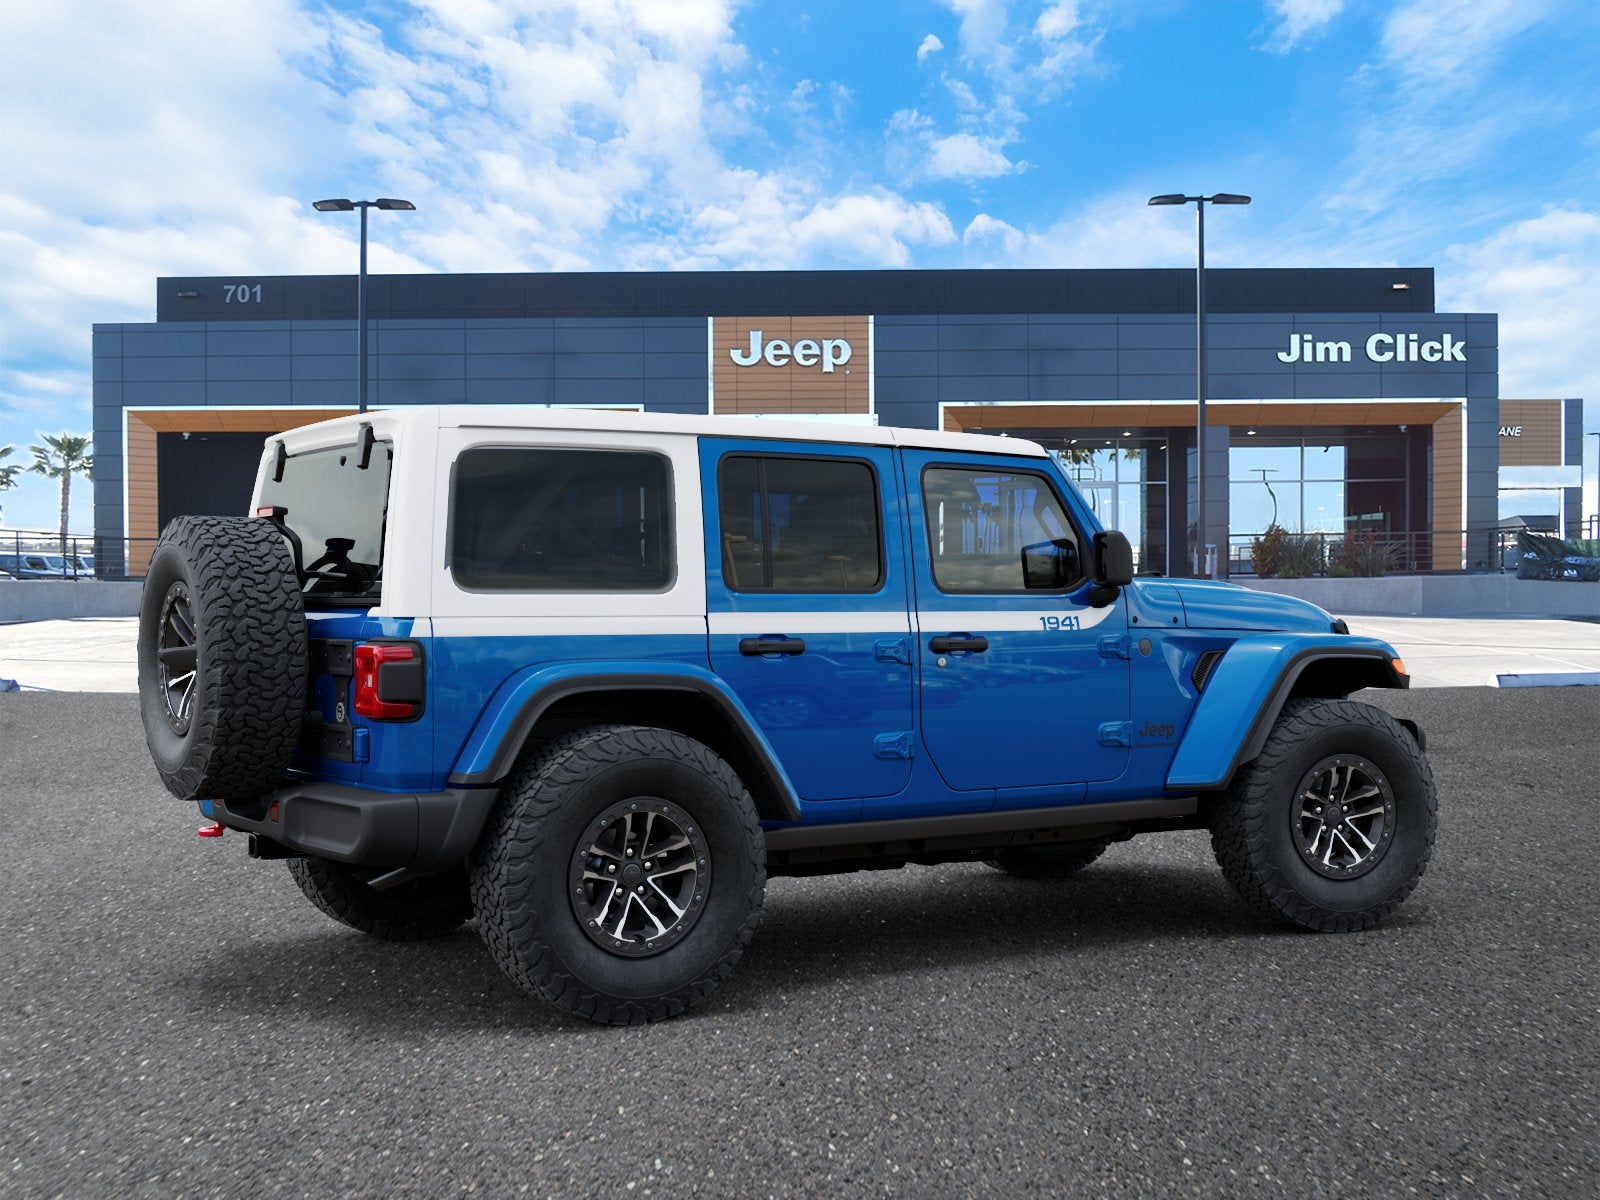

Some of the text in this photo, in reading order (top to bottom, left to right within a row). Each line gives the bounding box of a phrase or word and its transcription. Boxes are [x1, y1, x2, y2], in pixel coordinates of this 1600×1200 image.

[223, 284, 262, 303] 701
[729, 330, 852, 374] Jeep
[1277, 333, 1467, 363] Jim Click
[1039, 616, 1080, 631] 1941
[1139, 720, 1175, 739] Jeep
